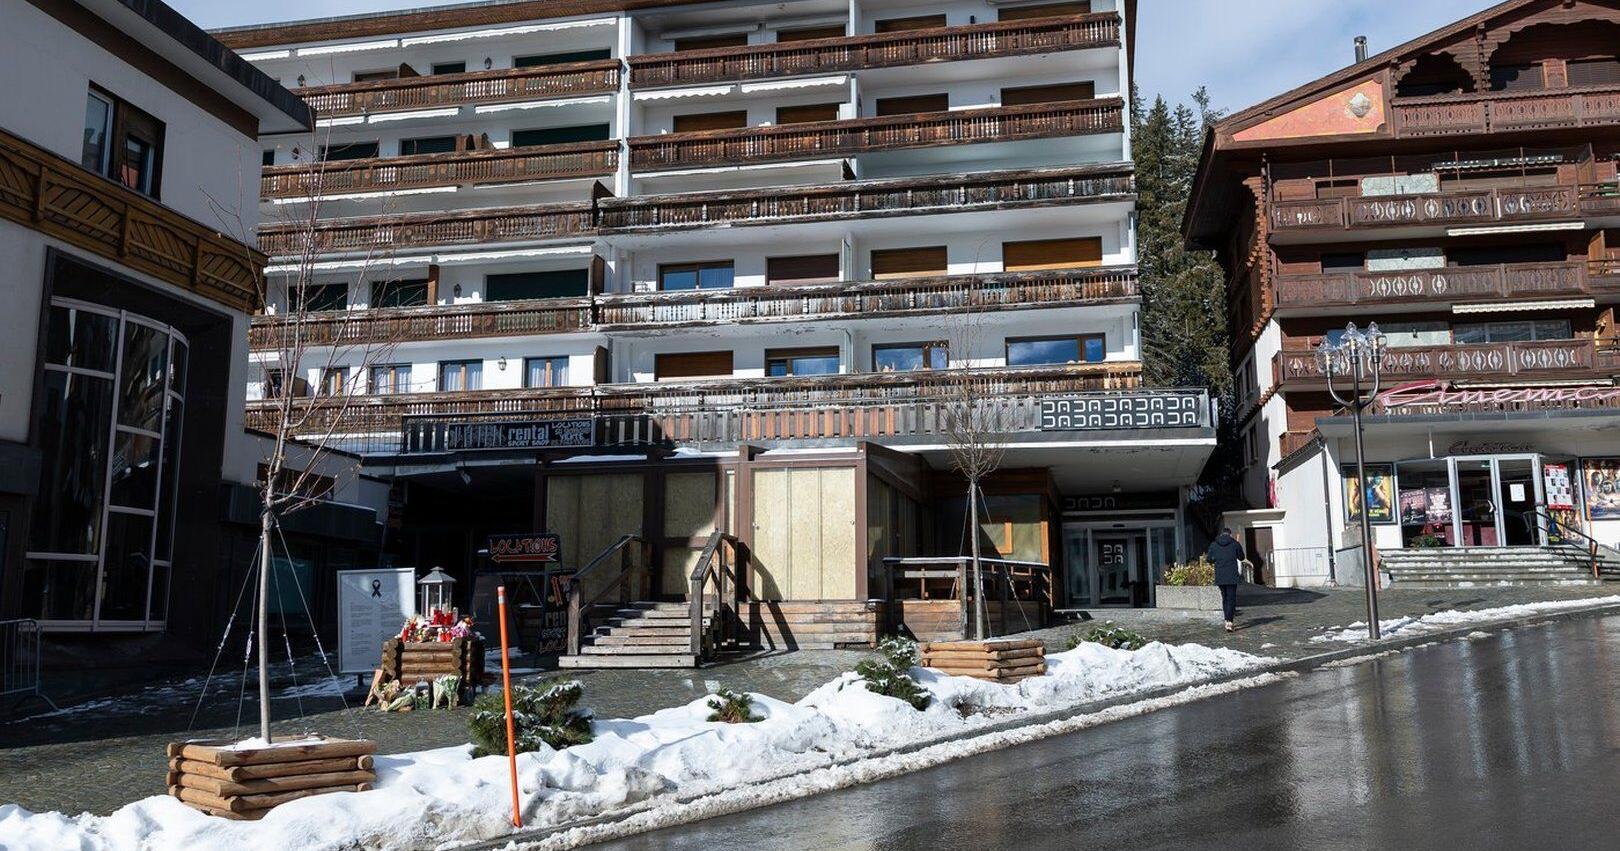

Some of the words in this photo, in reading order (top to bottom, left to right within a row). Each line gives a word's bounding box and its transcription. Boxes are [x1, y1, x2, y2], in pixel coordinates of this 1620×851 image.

[508, 424, 549, 441] rental
[551, 420, 592, 430] LOCATIONS
[489, 537, 558, 555] LOCATIONS
